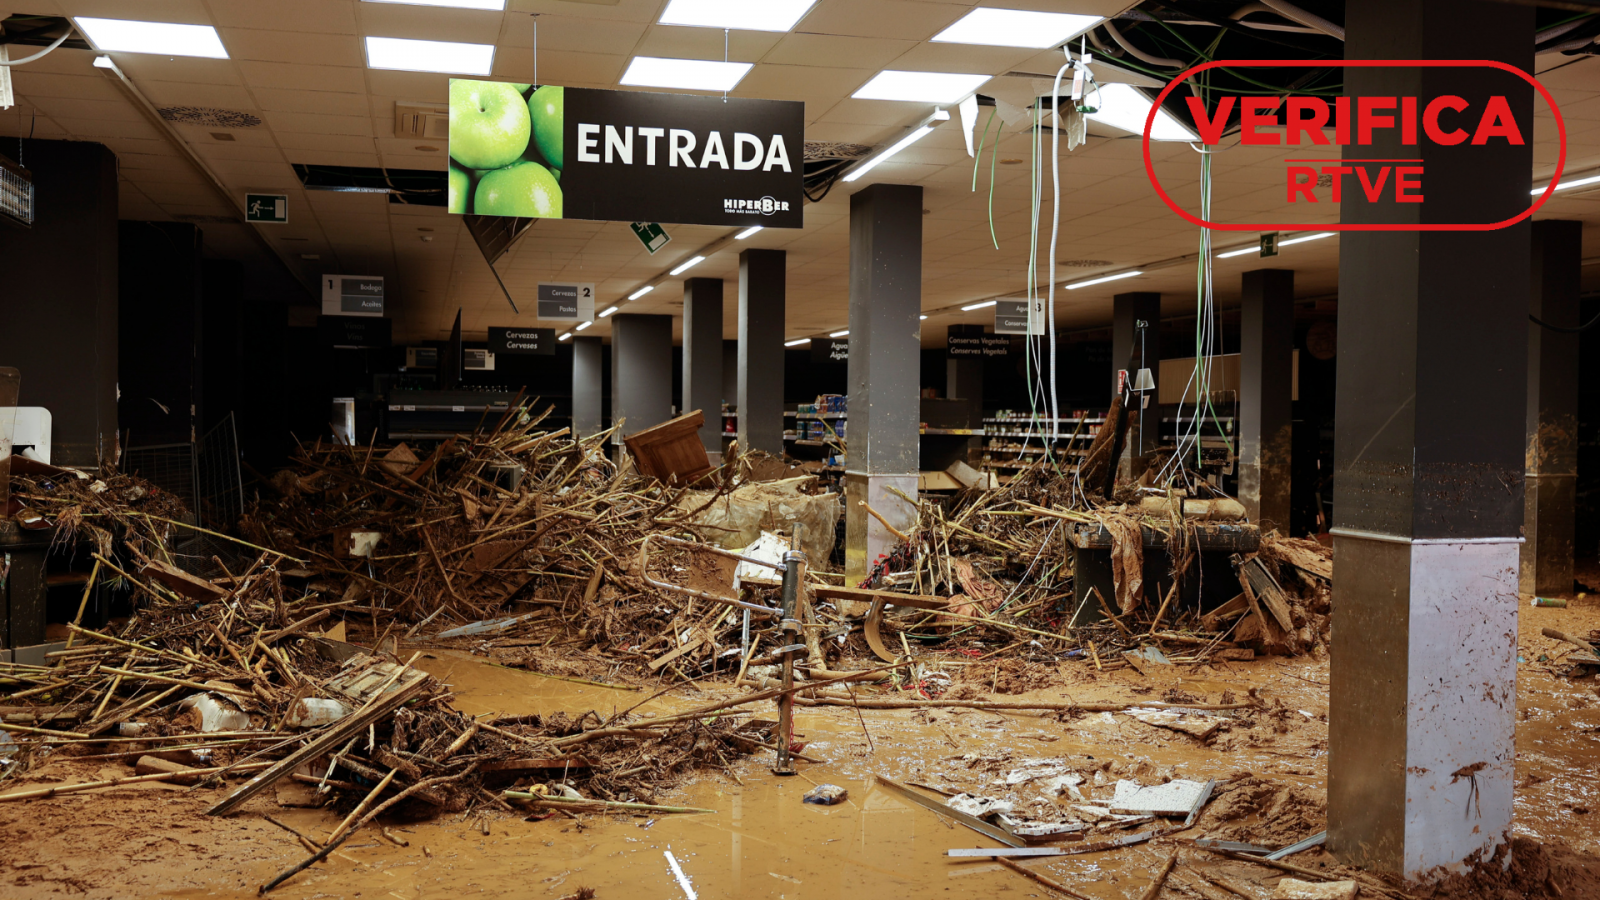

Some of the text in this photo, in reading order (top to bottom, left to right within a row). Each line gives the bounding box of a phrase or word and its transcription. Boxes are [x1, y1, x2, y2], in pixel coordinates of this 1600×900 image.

[577, 123, 792, 173] ENTRADA
[328, 280, 334, 289] 1
[360, 283, 382, 292] Bodega
[551, 289, 577, 298] Cervezas
[583, 287, 591, 298] 2
[361, 300, 382, 308] Aceites
[559, 306, 577, 314] Pastas
[344, 321, 366, 330] Vinos
[1004, 319, 1028, 327] Conserva
[346, 332, 364, 341] Vins
[505, 331, 538, 340] Cervezas
[506, 341, 538, 350] Cerveses
[948, 336, 1010, 346] Conservas Vegetales
[830, 342, 848, 351] Agua
[829, 351, 849, 361] Aigüe
[950, 346, 1007, 357] Conserves Vegetals
